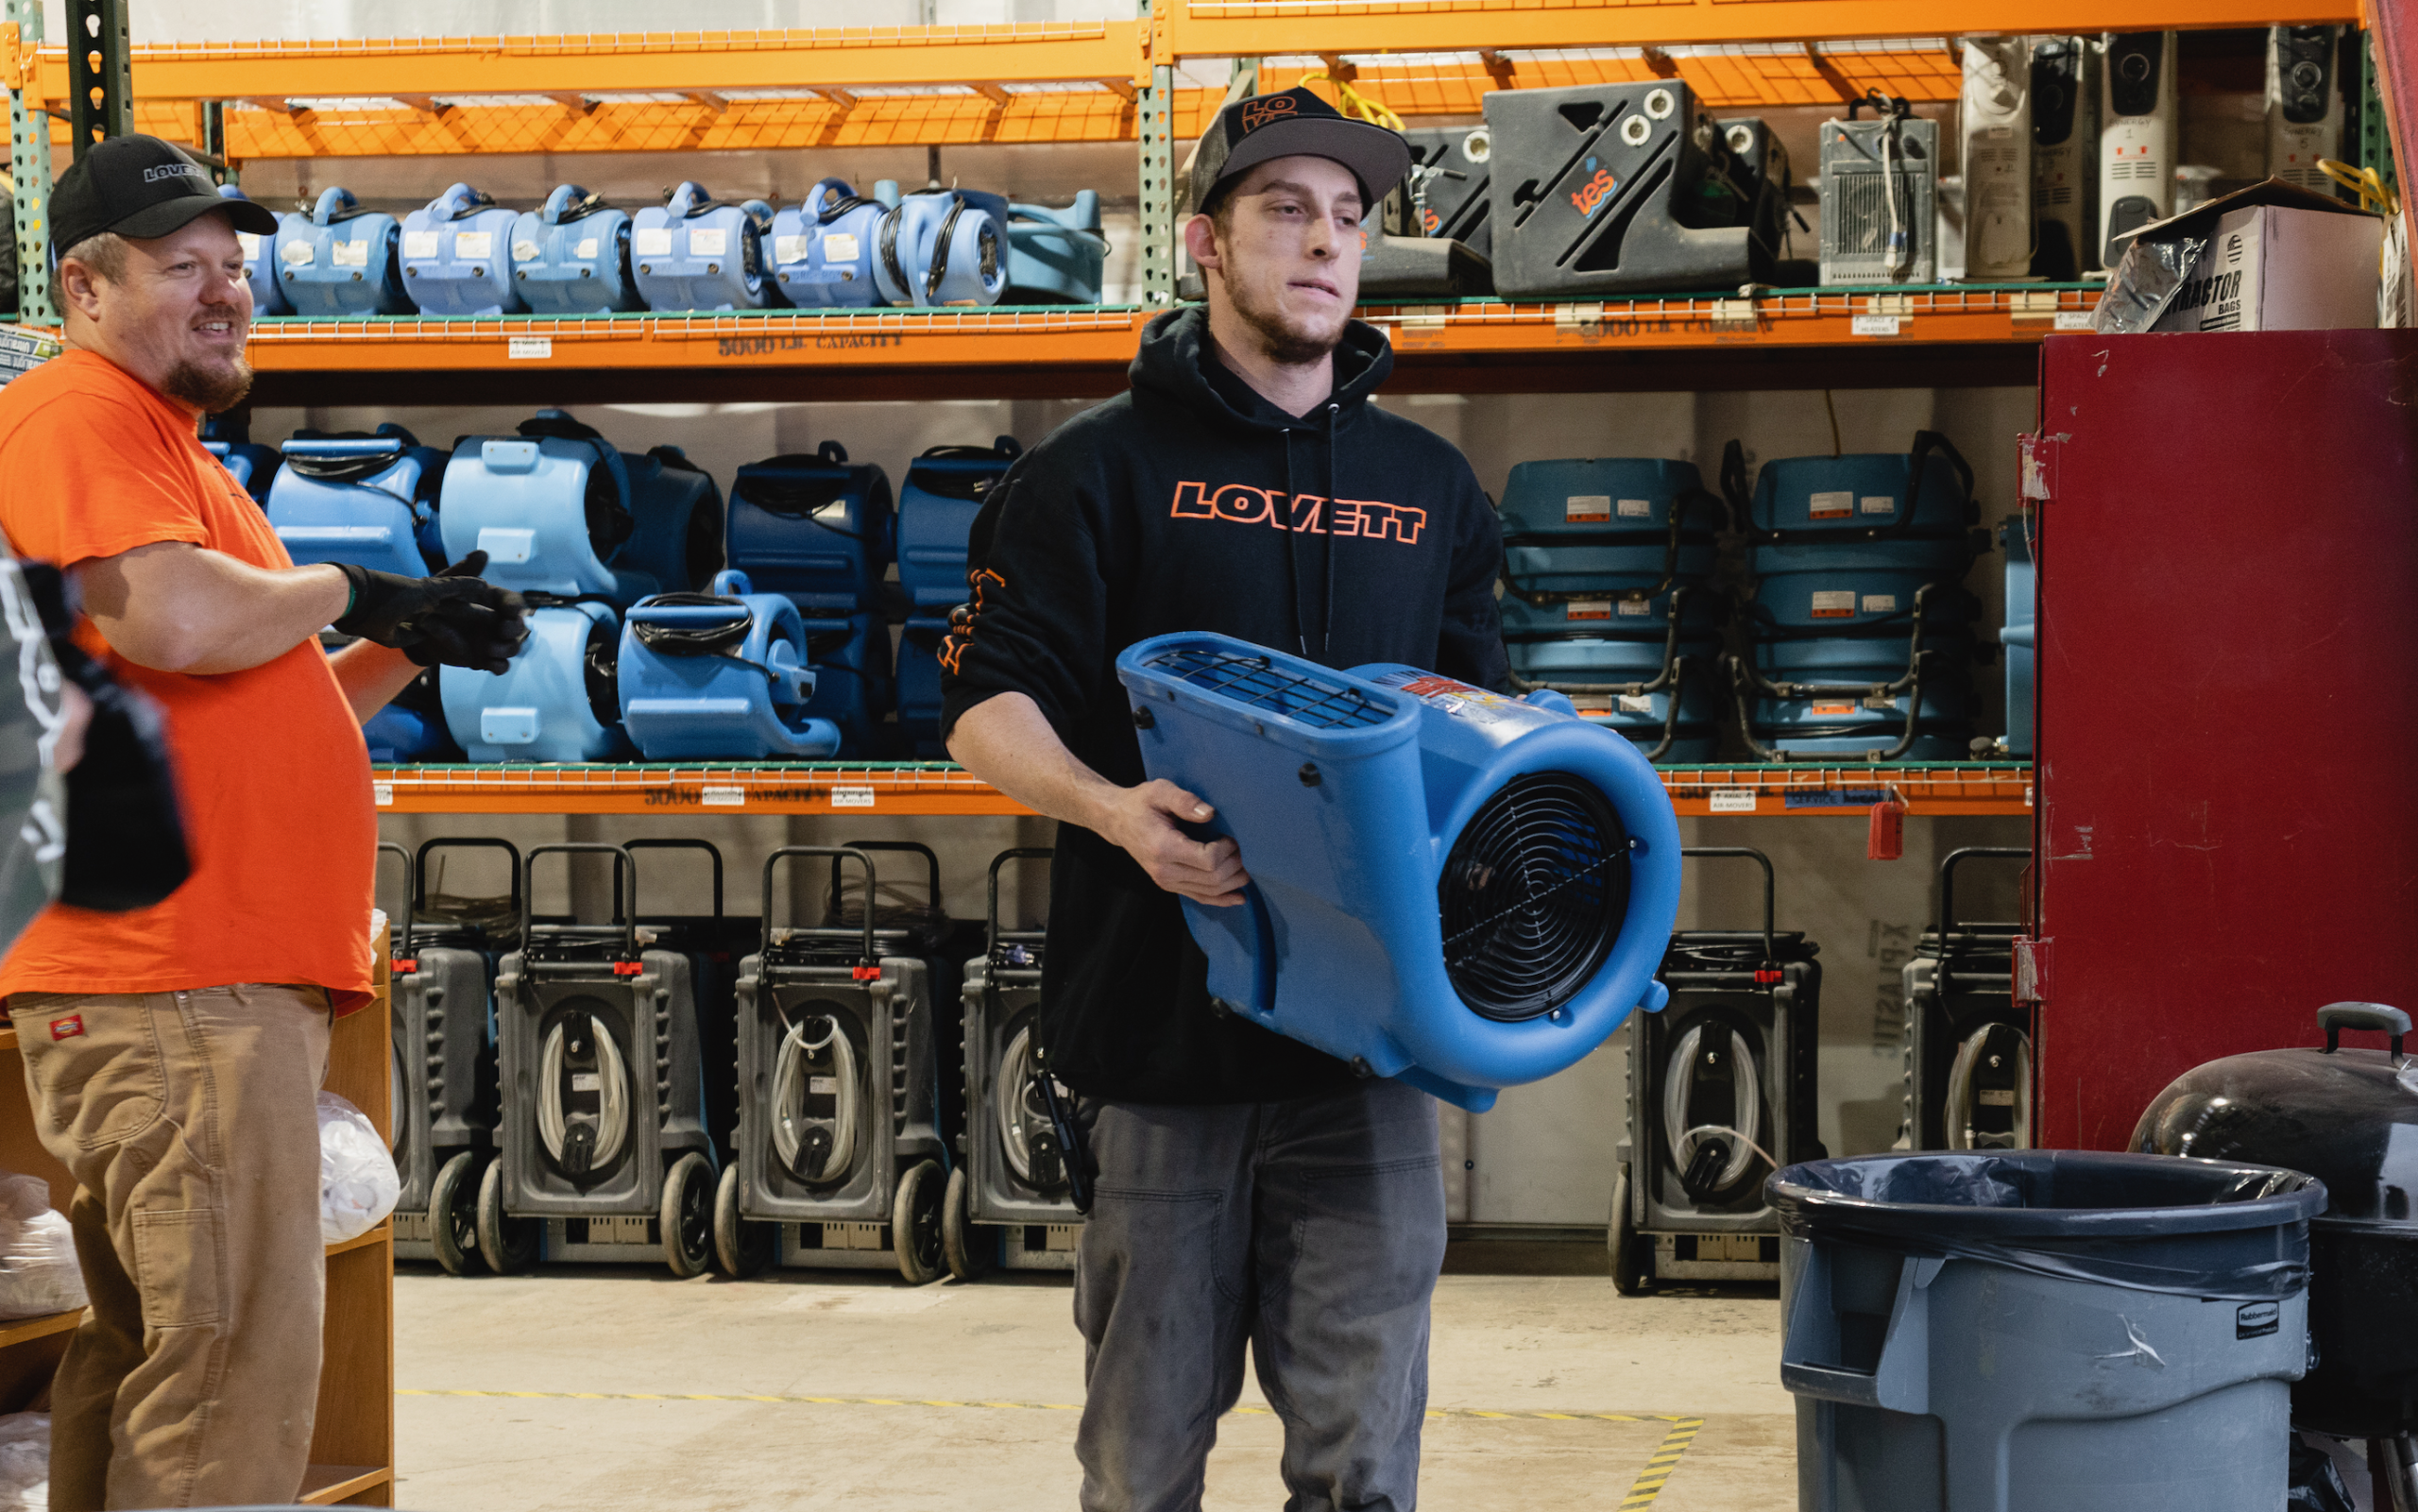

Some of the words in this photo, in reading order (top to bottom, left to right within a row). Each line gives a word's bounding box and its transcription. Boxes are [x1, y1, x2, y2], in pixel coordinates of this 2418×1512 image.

[1571, 169, 1615, 215] tes
[2218, 299, 2241, 315] BAGS
[718, 336, 775, 356] 5000
[815, 332, 903, 348] CAPACITY
[1170, 481, 1427, 545] LOVETT
[2240, 1307, 2277, 1321] Rubbermaid
